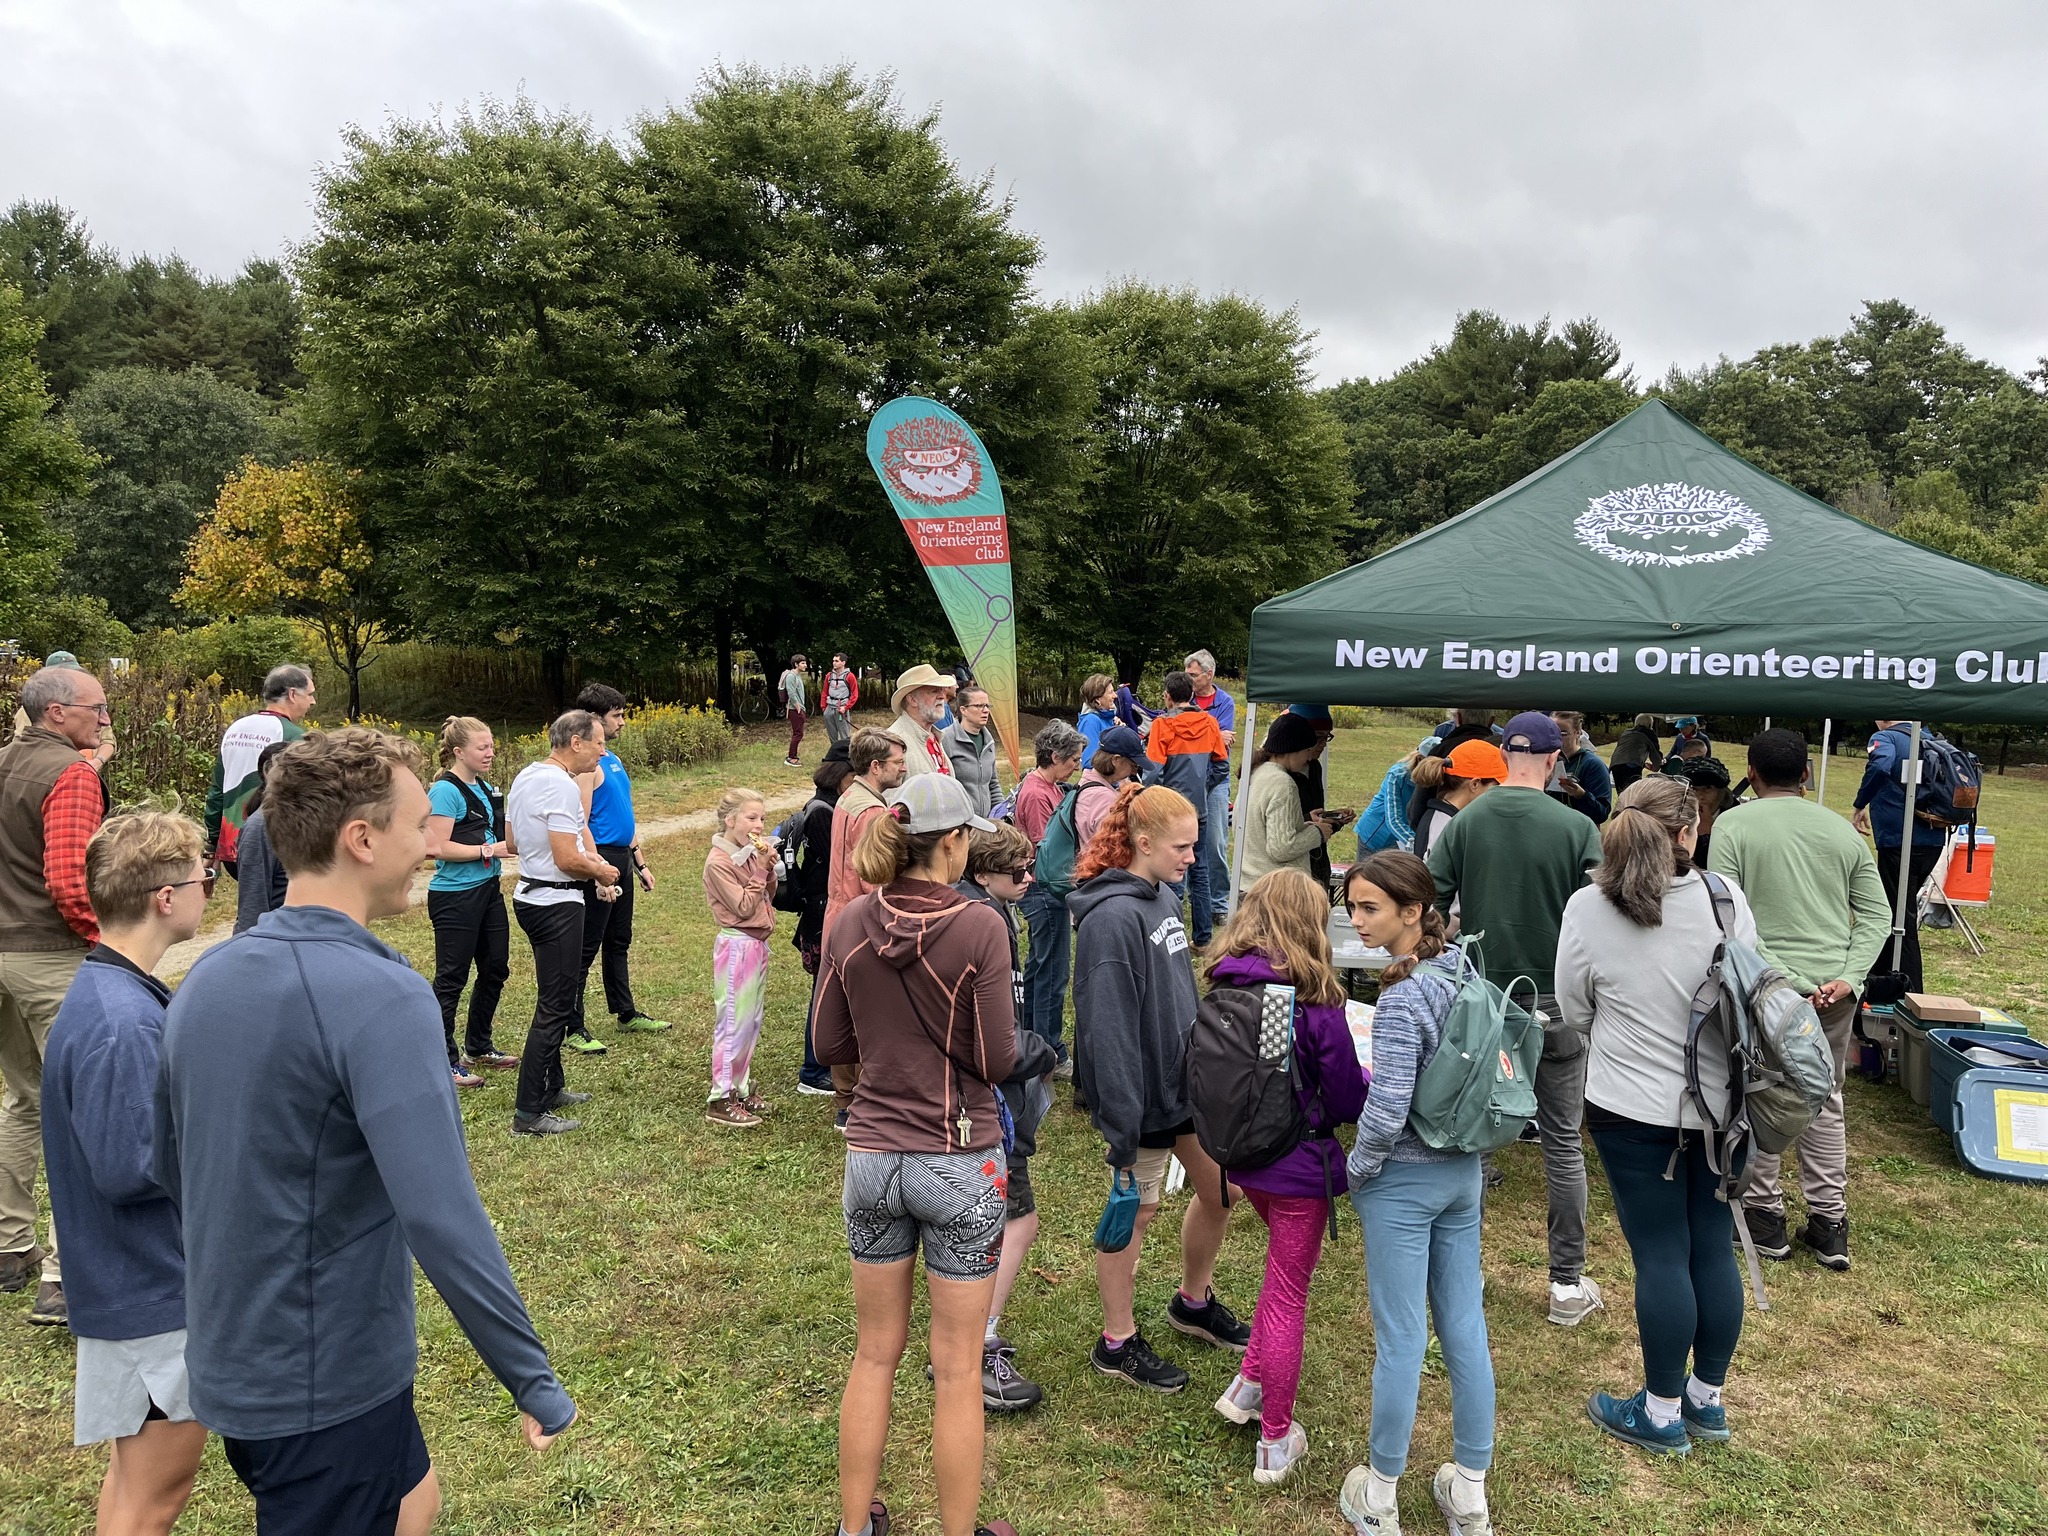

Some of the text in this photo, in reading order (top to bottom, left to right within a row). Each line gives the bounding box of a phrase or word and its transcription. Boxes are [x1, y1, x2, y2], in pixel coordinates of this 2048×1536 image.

[920, 451, 950, 464] NEOC
[917, 517, 1002, 535] New England
[1639, 512, 1710, 527] NEOC
[920, 533, 1003, 548] Orienteering
[975, 546, 1004, 560] Club
[1335, 639, 1429, 669] New
[1442, 641, 1618, 679] England
[1635, 646, 1937, 690] Orienteering
[1363, 1514, 1381, 1528] HOKA
